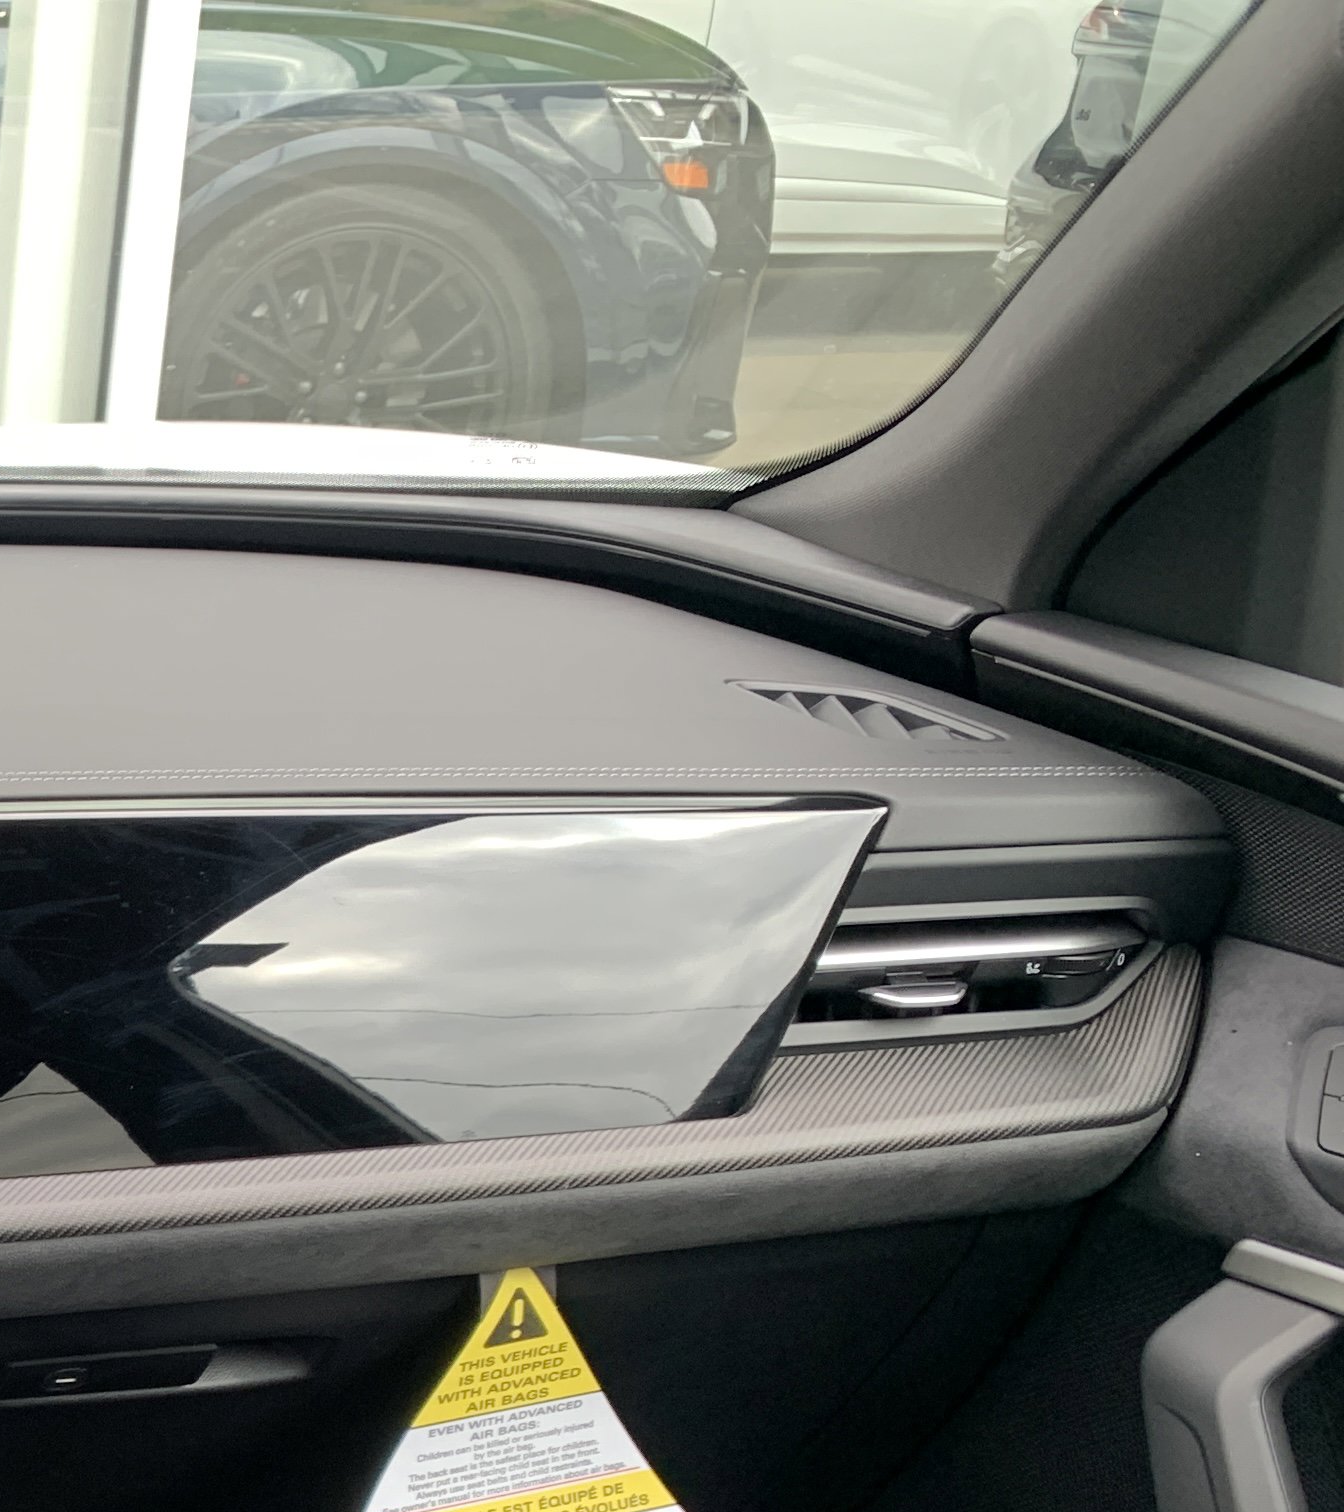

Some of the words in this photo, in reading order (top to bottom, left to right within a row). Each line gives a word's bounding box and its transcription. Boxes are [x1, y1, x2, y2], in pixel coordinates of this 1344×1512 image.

[458, 1374, 473, 1386] IS
[479, 1356, 563, 1382] EQUIPPED
[460, 1356, 495, 1372] THIS
[500, 1341, 568, 1363] VEHICLE
[437, 1386, 481, 1404] WITH
[486, 1366, 581, 1394] ADVANCED
[465, 1397, 495, 1413] AIR
[500, 1386, 549, 1405] BAGS
[428, 1423, 464, 1438] EVEN
[468, 1415, 504, 1430] WITH
[508, 1398, 582, 1421] ADVANCED
[470, 1429, 493, 1441] AIR
[498, 1419, 539, 1436] BAGS:
[417, 1448, 453, 1462] Children
[455, 1446, 471, 1454] can
[473, 1441, 484, 1450] be
[563, 1420, 593, 1433] injured
[486, 1448, 501, 1457] the
[407, 1480, 433, 1492] Never
[436, 1478, 450, 1487] put
[508, 1460, 529, 1471] child
[531, 1457, 549, 1466] seat
[560, 1451, 575, 1460] the
[408, 1472, 425, 1482] The
[427, 1467, 448, 1478] back
[449, 1464, 467, 1474] seat
[478, 1458, 493, 1467] the
[522, 1448, 545, 1460] place
[547, 1445, 560, 1453] for
[415, 1487, 447, 1501] Always
[466, 1480, 484, 1489] seat
[486, 1474, 507, 1485] belts
[528, 1466, 549, 1476] child
[537, 1484, 596, 1511] ÉQUIPÉ
[603, 1481, 623, 1497] DE
[401, 1498, 436, 1512] owner's
[438, 1491, 470, 1504] manual
